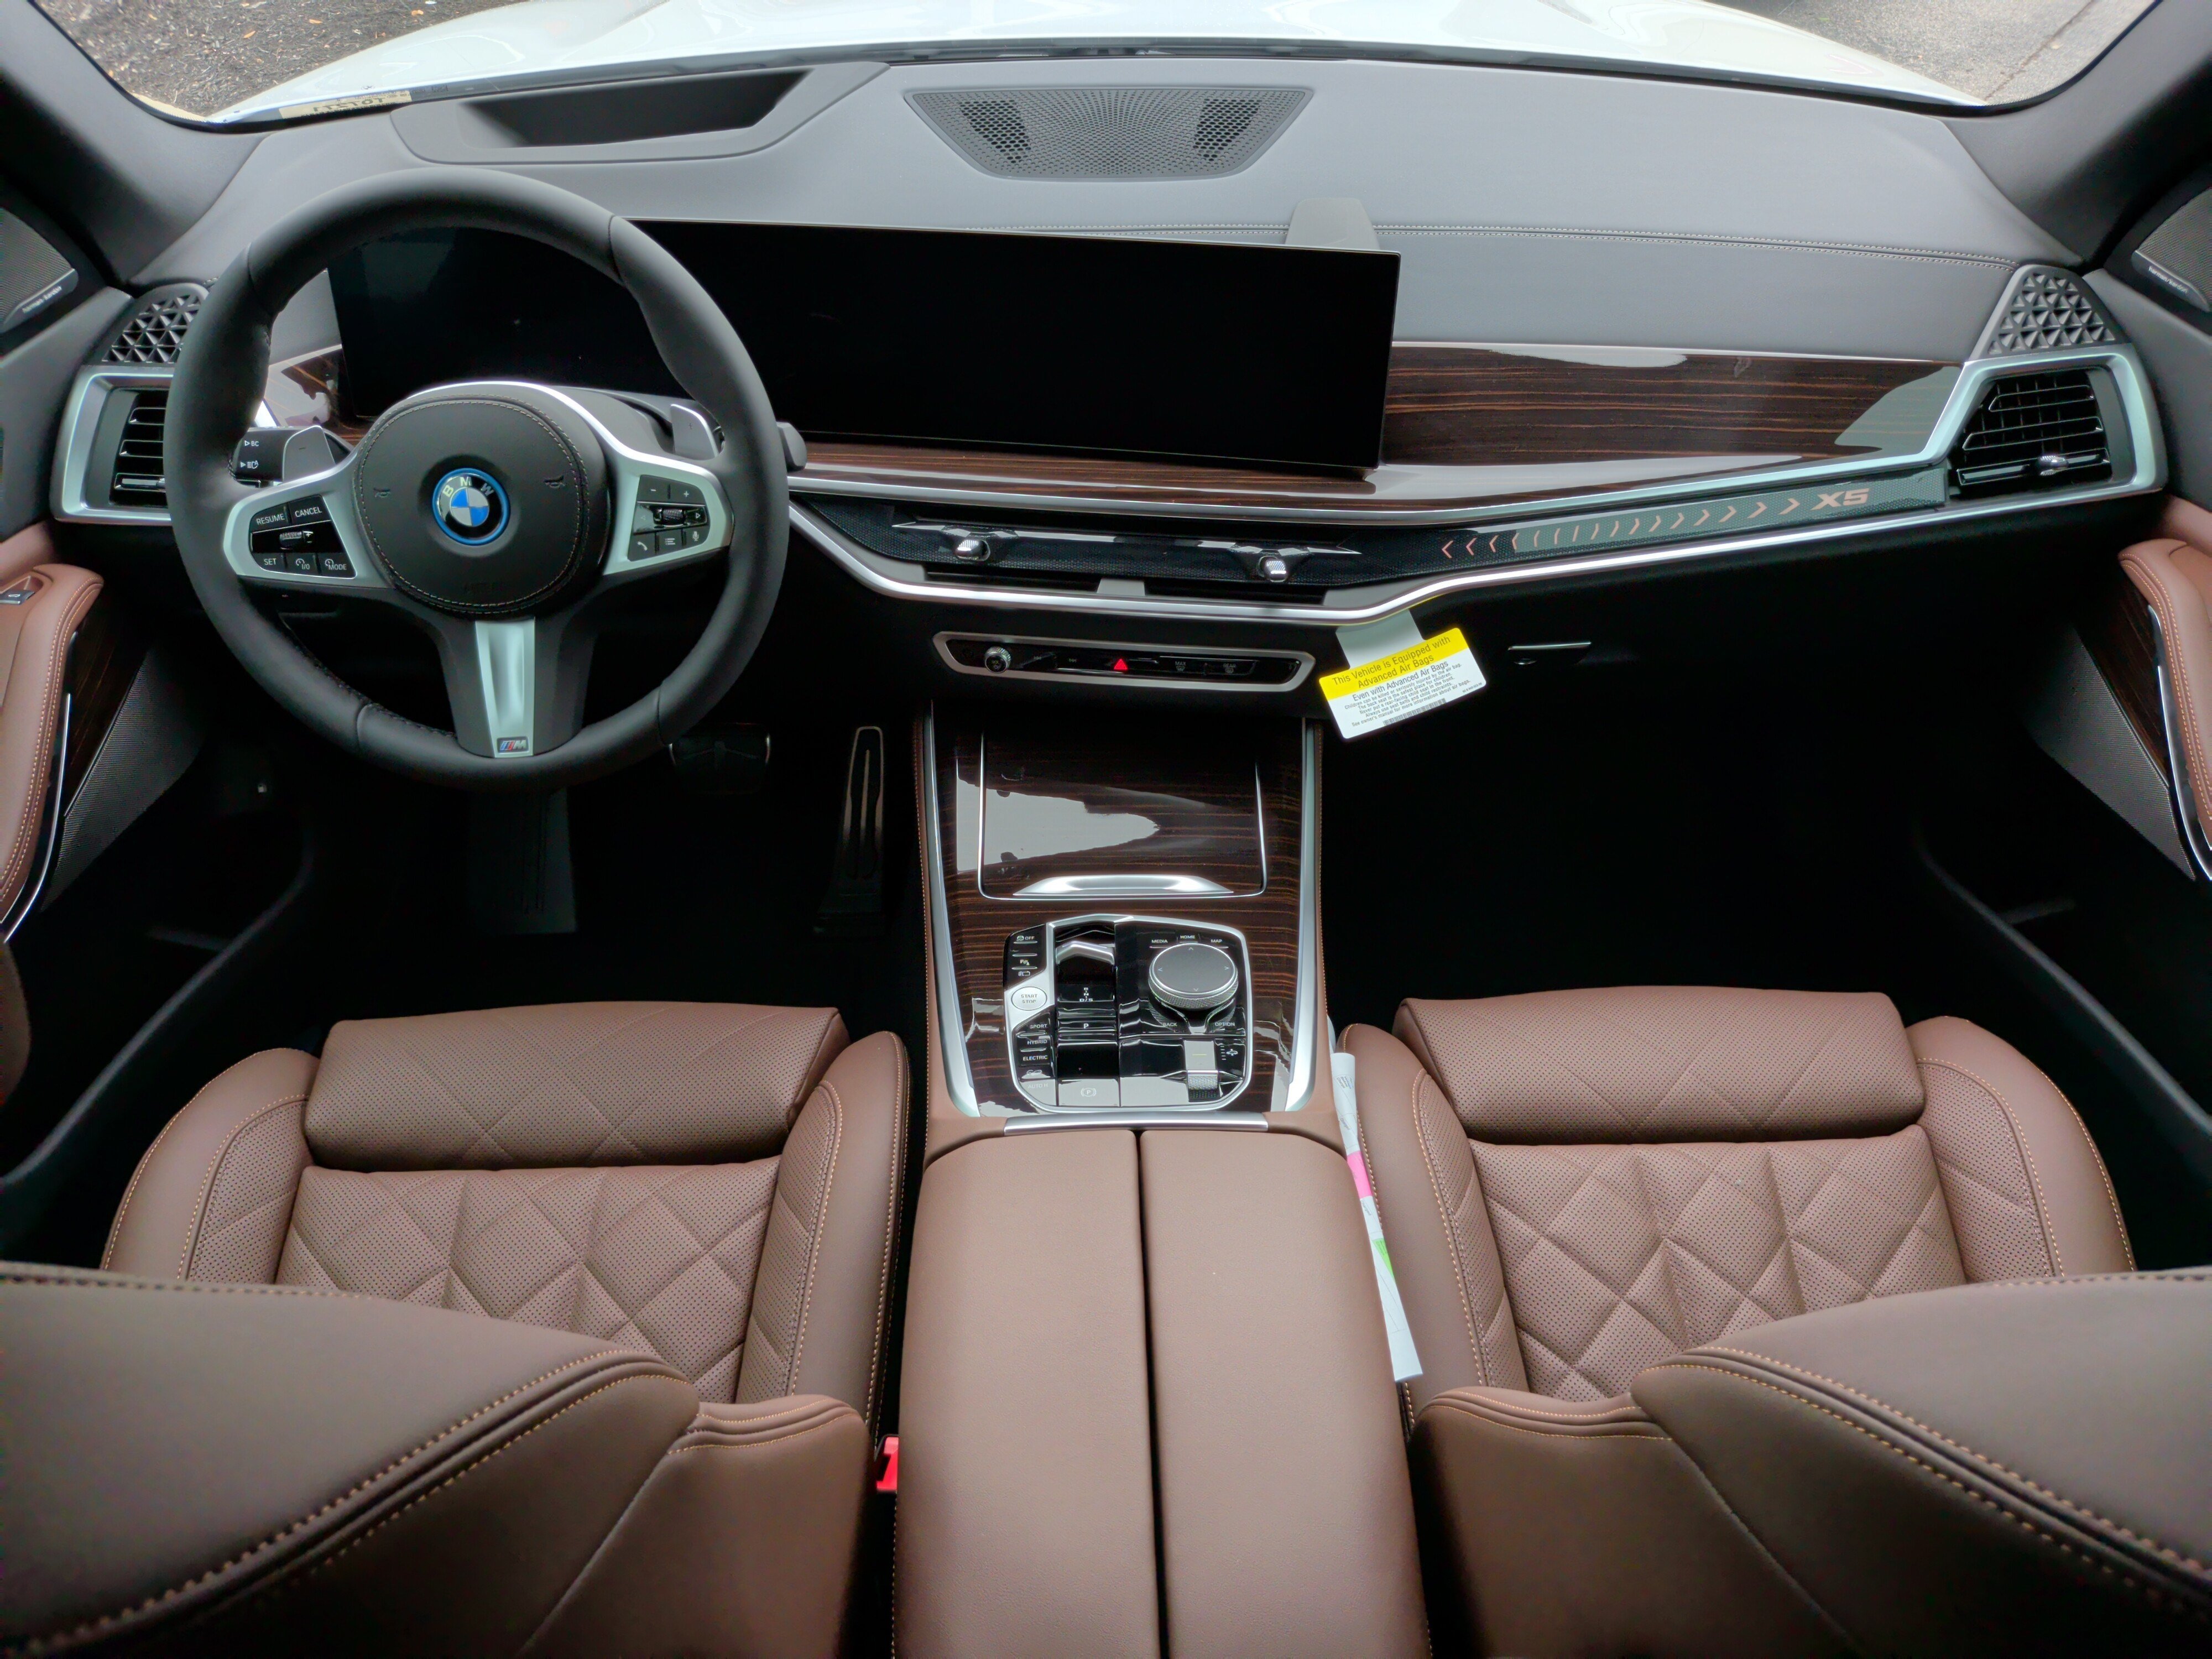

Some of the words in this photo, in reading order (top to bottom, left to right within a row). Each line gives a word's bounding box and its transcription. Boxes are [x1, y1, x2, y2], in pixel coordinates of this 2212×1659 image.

[442, 476, 494, 497] BMW
[1811, 488, 1869, 510] X5
[257, 514, 285, 525] RESUME
[295, 507, 322, 518] CANCEL
[1332, 675, 1350, 685] This
[1351, 664, 1381, 679] Vehicle
[1392, 644, 1431, 664] Equipped
[1432, 637, 1450, 648] with
[1358, 667, 1397, 687] Advanced
[1399, 663, 1410, 673] Air
[1412, 655, 1434, 667] Bags
[1352, 691, 1369, 701] Even
[1370, 685, 1385, 695] with
[1386, 672, 1418, 689] Advanced
[1420, 669, 1429, 677] Air
[1430, 661, 1448, 672] Bags
